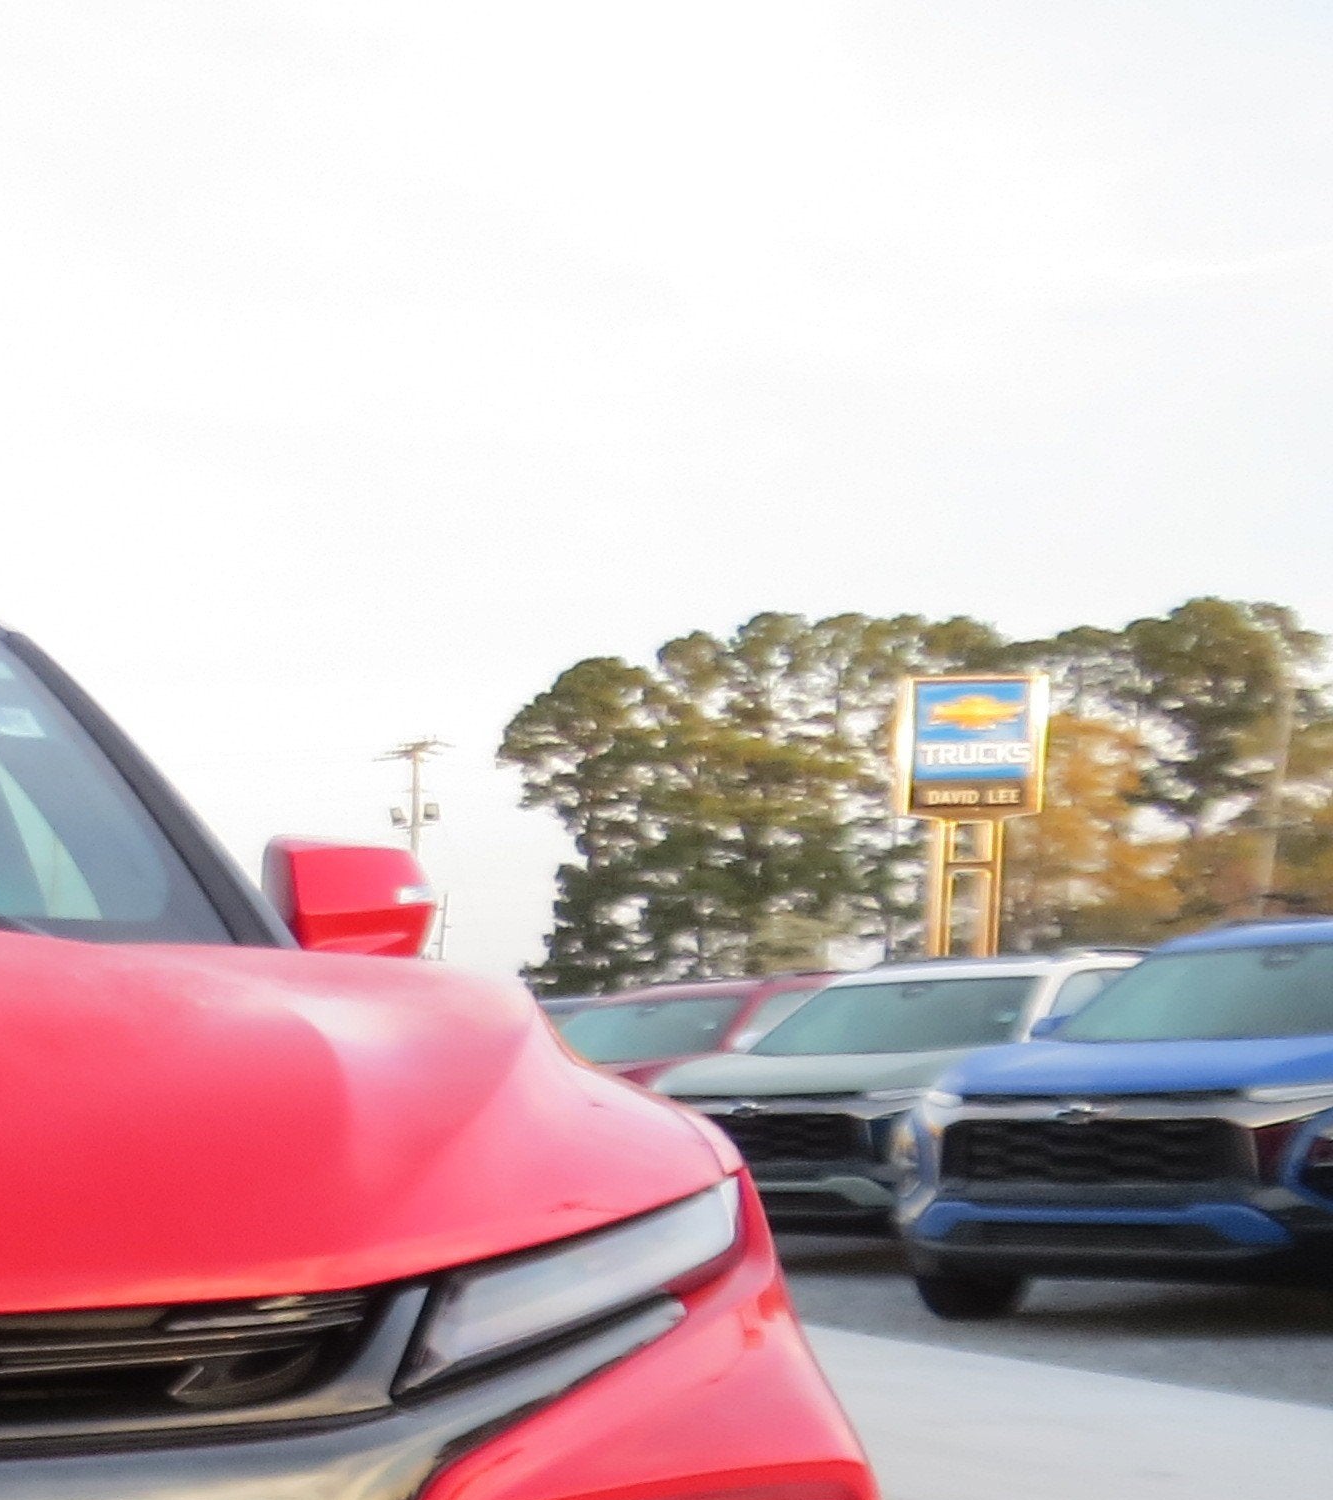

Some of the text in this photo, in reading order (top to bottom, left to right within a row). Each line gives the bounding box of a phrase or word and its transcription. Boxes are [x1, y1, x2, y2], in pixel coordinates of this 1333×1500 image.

[920, 743, 1031, 764] TRUCKS
[926, 787, 1021, 805] DAVID LEE
